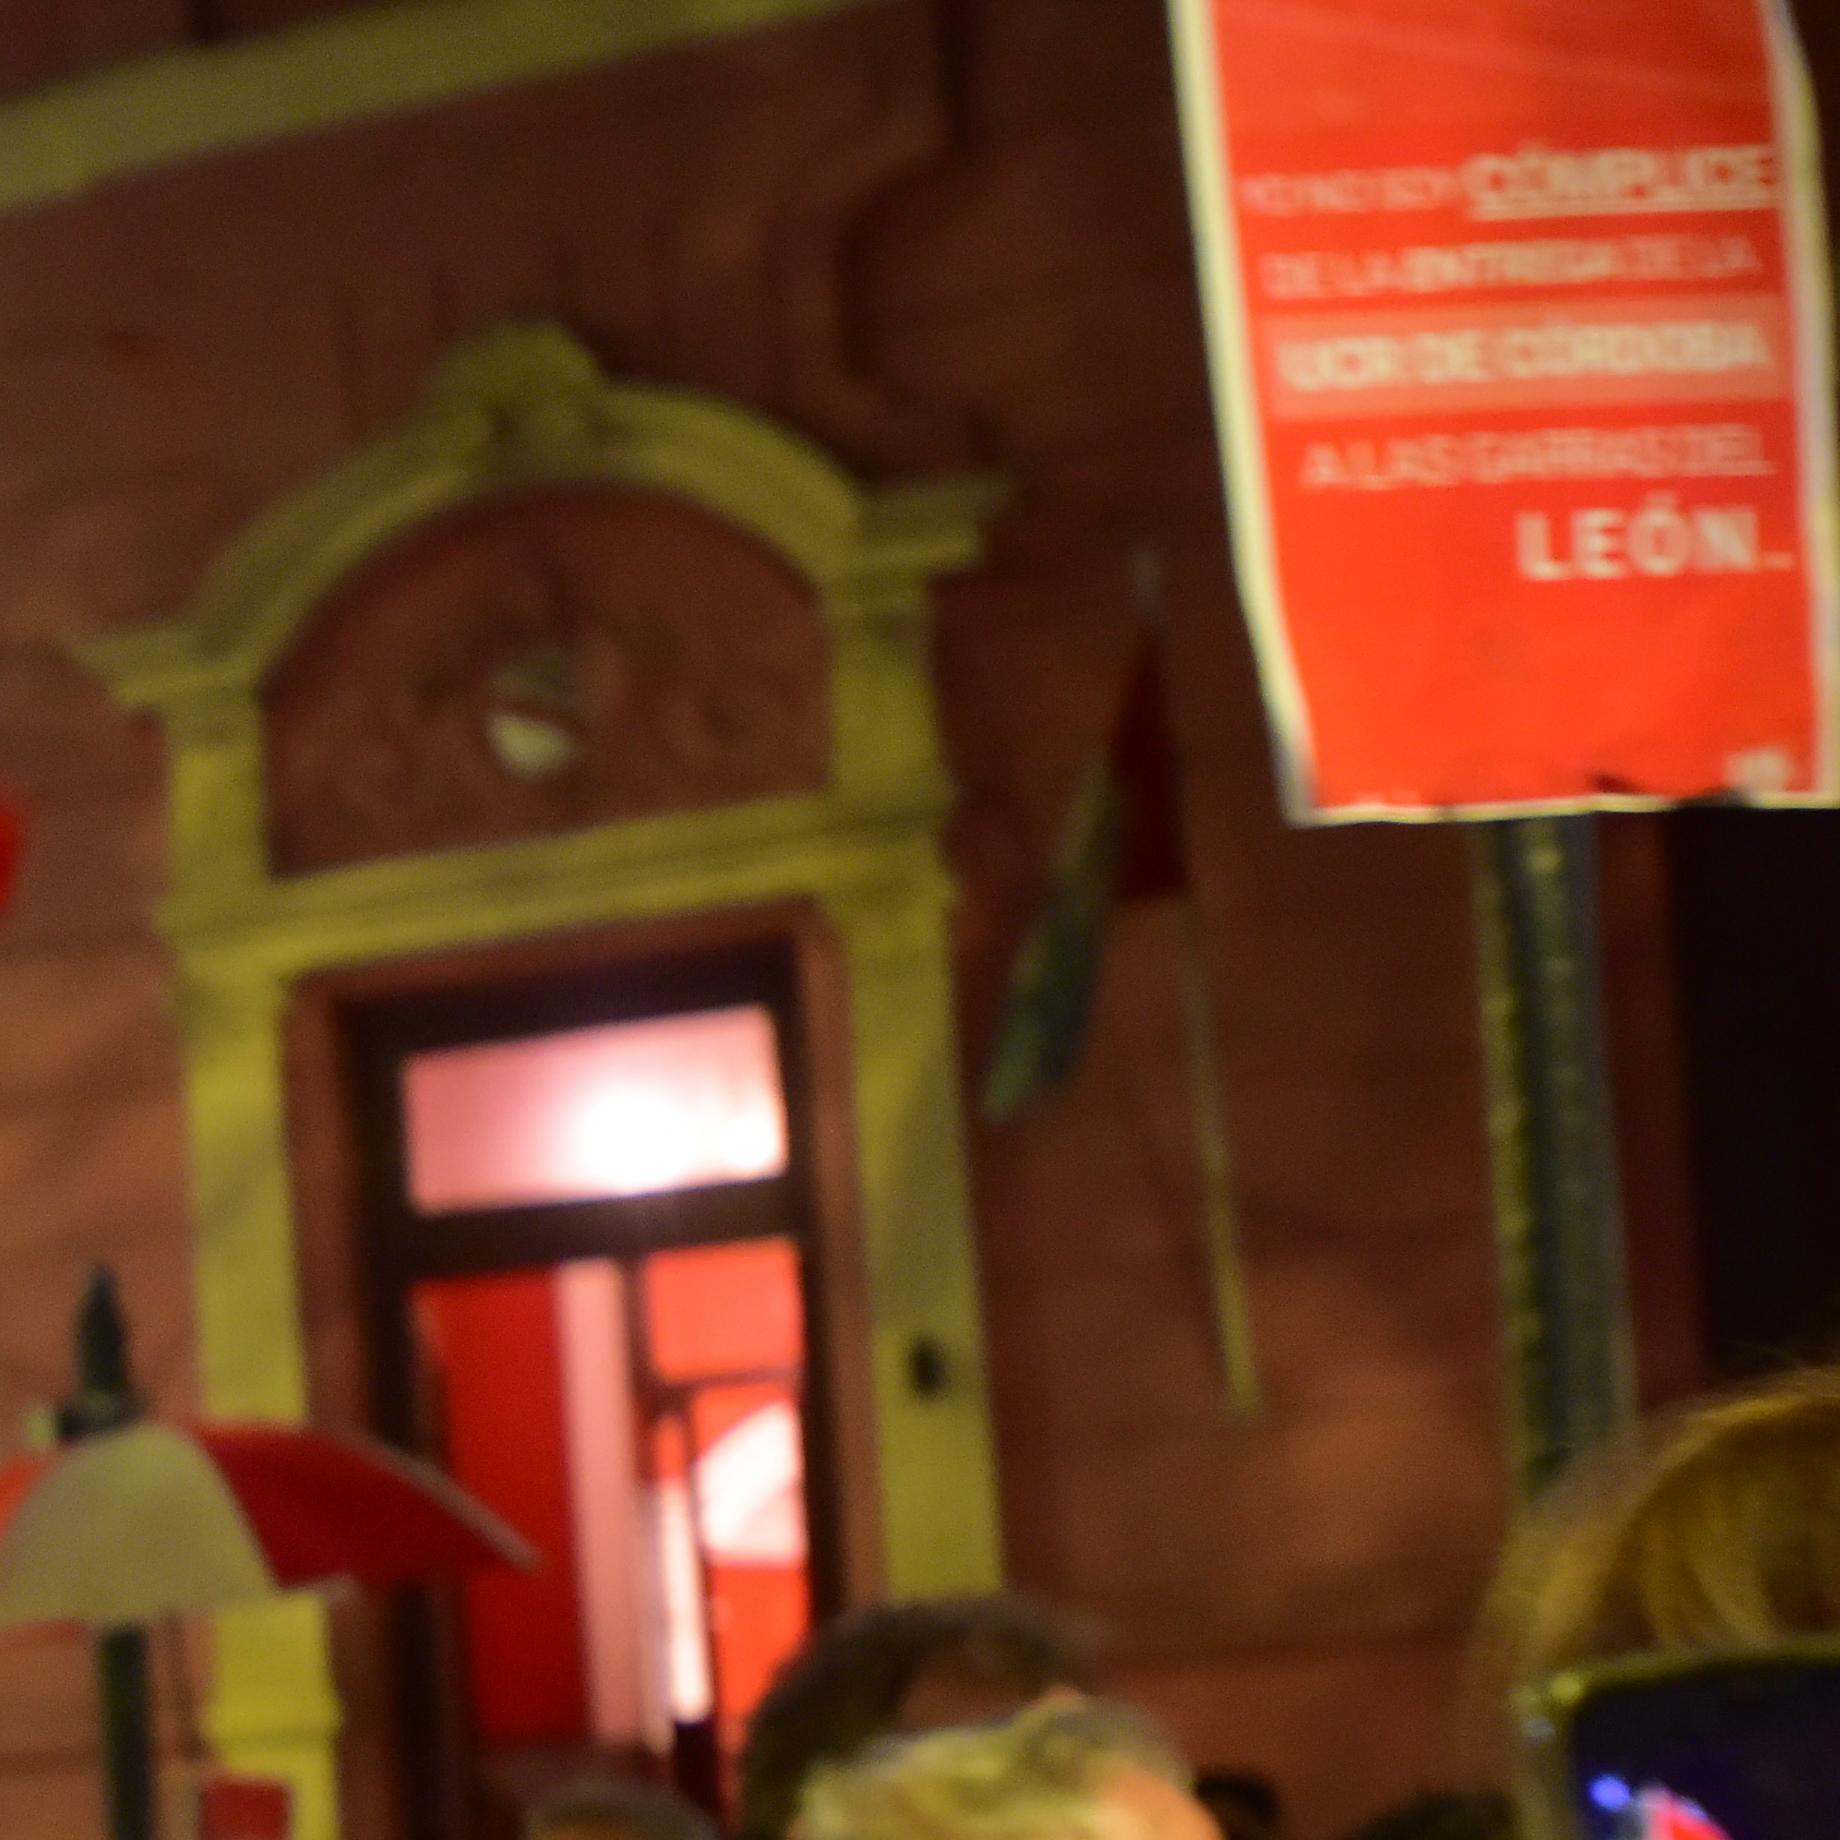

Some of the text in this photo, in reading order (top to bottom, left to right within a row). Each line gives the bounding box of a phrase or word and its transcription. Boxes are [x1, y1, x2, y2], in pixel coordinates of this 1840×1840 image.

[1460, 138, 1778, 208] CÓMPLICE
[1273, 335, 1403, 392] UCR
[1406, 328, 1500, 385] DE
[1514, 490, 1794, 582] LEÓN.
